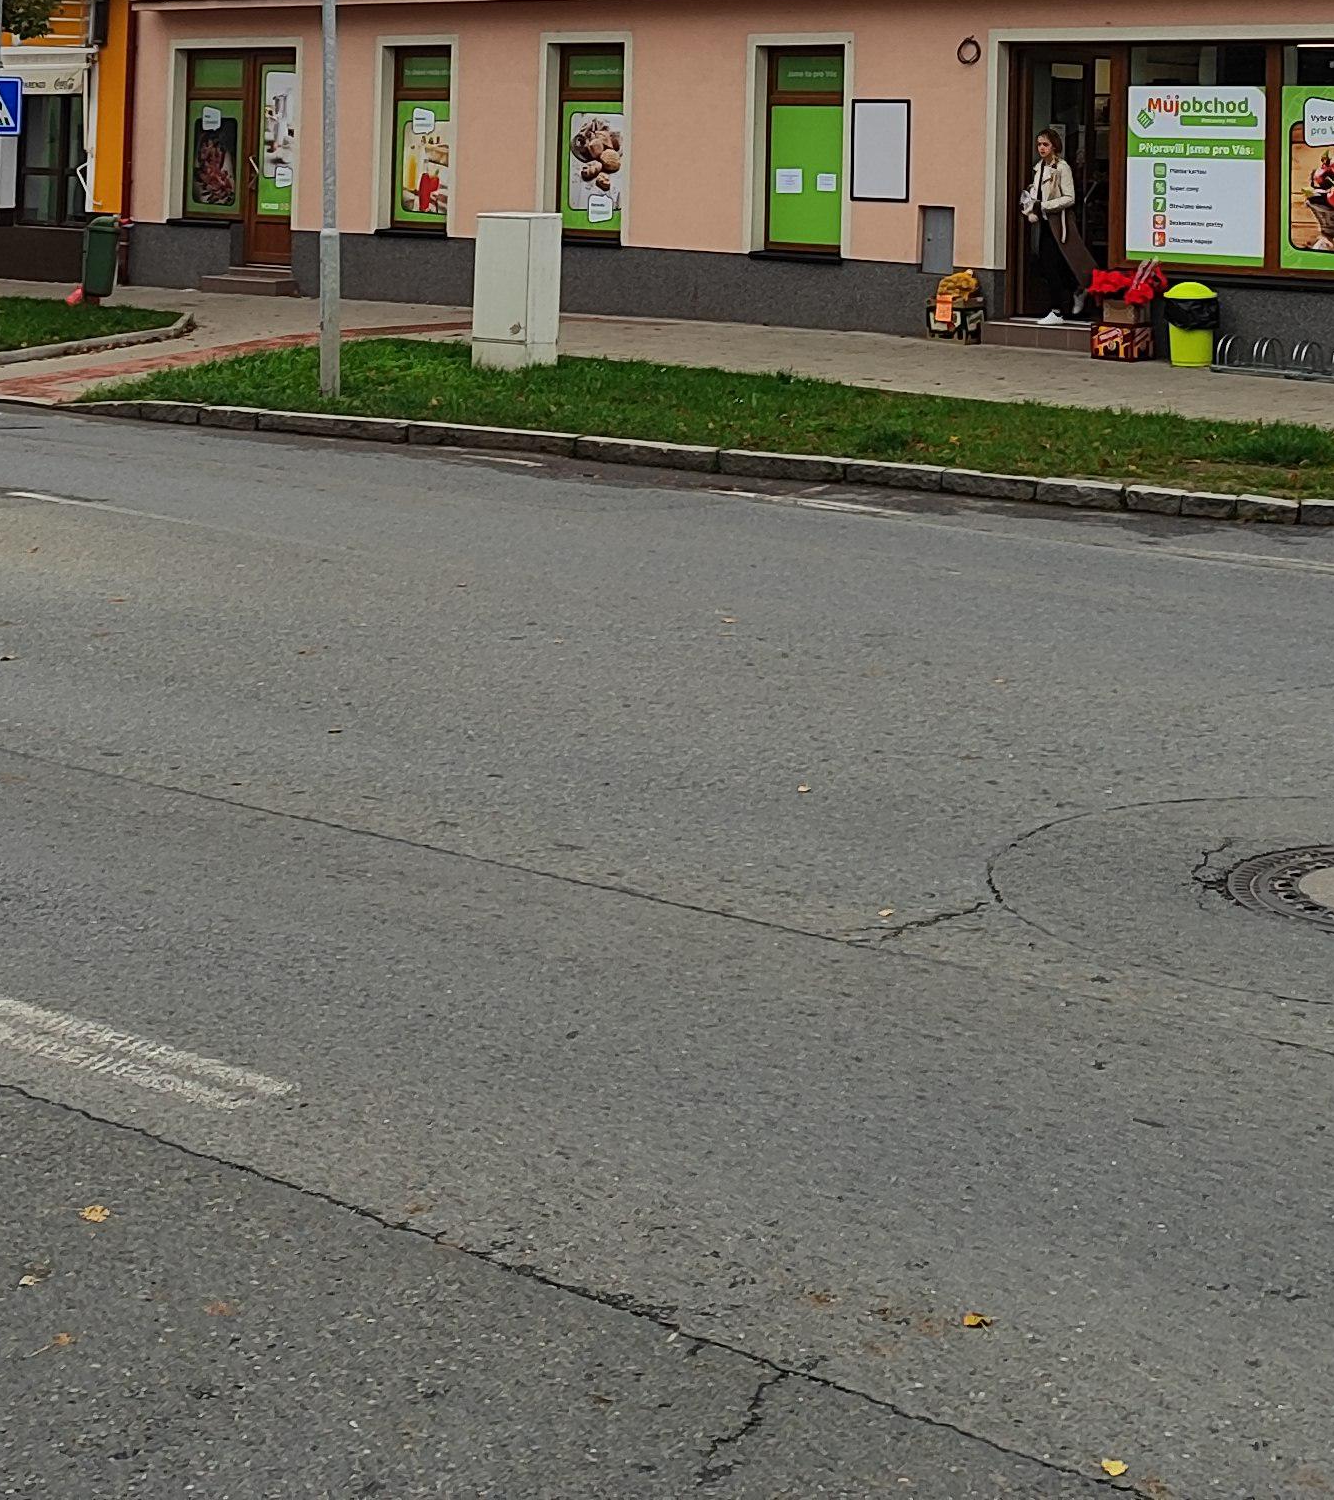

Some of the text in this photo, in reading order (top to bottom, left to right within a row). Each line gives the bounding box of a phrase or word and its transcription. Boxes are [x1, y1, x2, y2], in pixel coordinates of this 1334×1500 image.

[1147, 95, 1249, 116] Můjobchod
[1310, 128, 1327, 136] pro
[1138, 142, 1185, 155] Připravili
[1185, 144, 1211, 156] jsme
[1212, 146, 1230, 156] pro
[1155, 199, 1165, 211] 7
